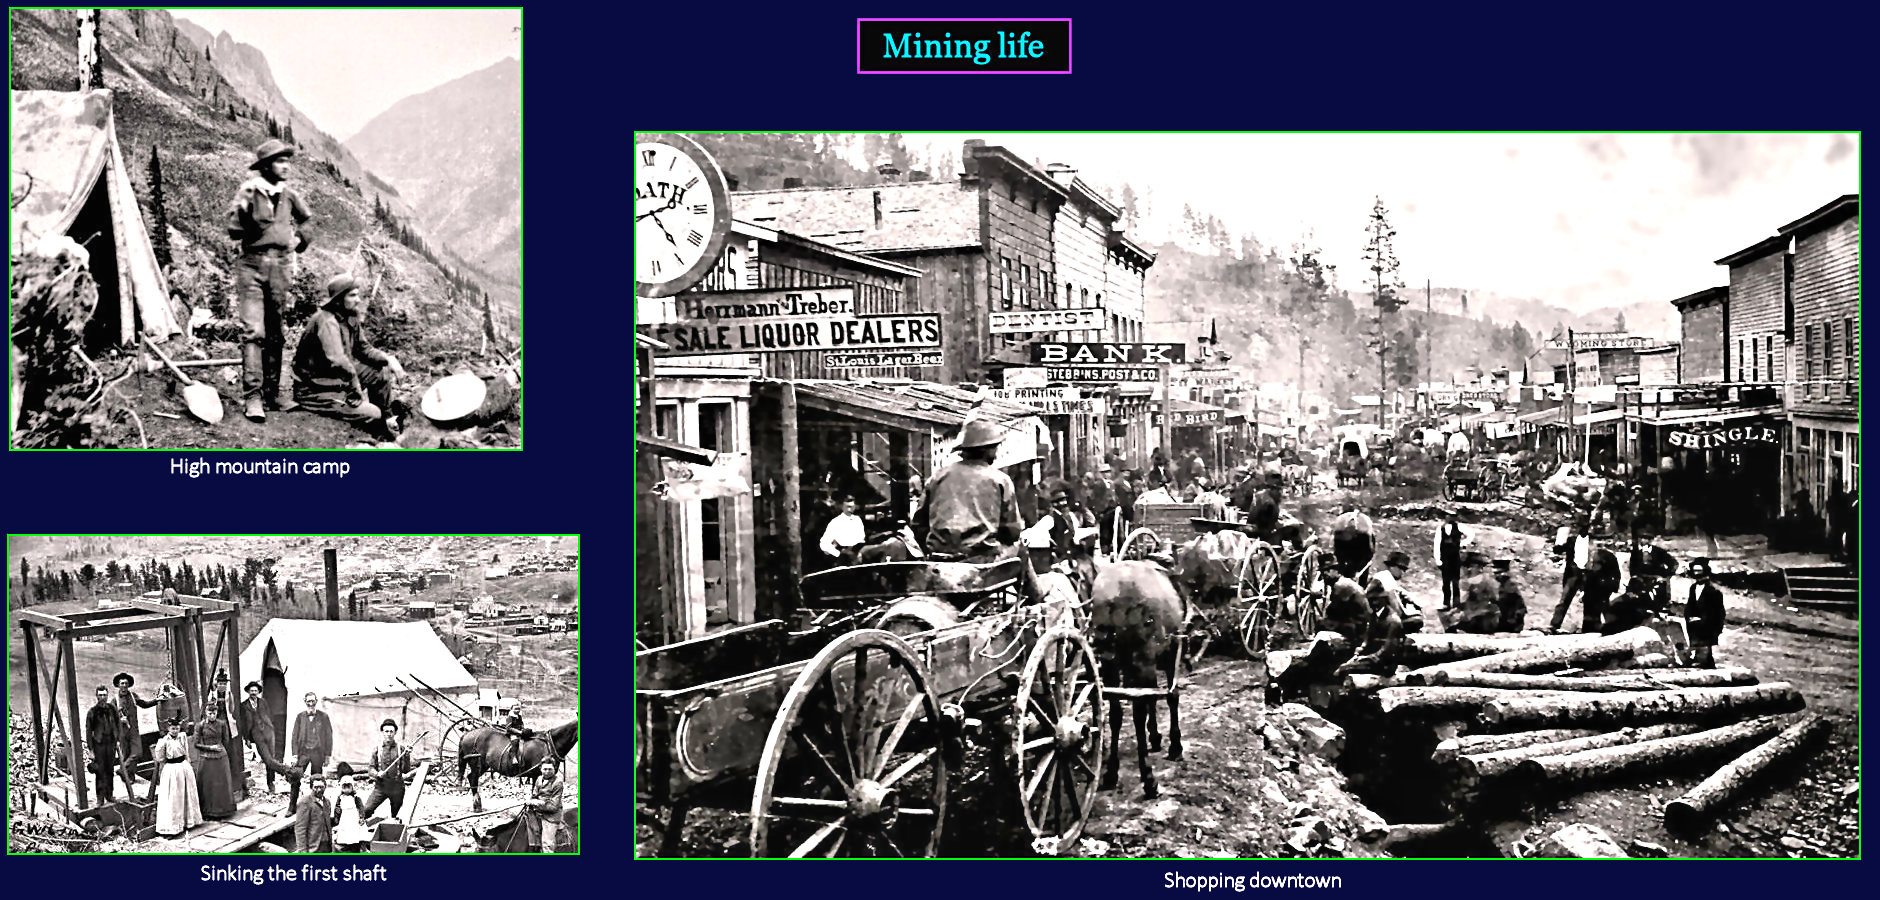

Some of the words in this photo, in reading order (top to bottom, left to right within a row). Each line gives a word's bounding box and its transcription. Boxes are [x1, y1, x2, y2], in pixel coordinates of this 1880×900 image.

[785, 293, 853, 315] Treber.
[992, 311, 1094, 328] DENTIST
[739, 322, 820, 348] LIQUOR
[830, 319, 938, 346] DEALERS
[1040, 344, 1181, 363] BANK.
[1015, 389, 1064, 399] PRINTING
[1186, 412, 1218, 424] BIRD
[1668, 426, 1779, 449] SHINGLE.
